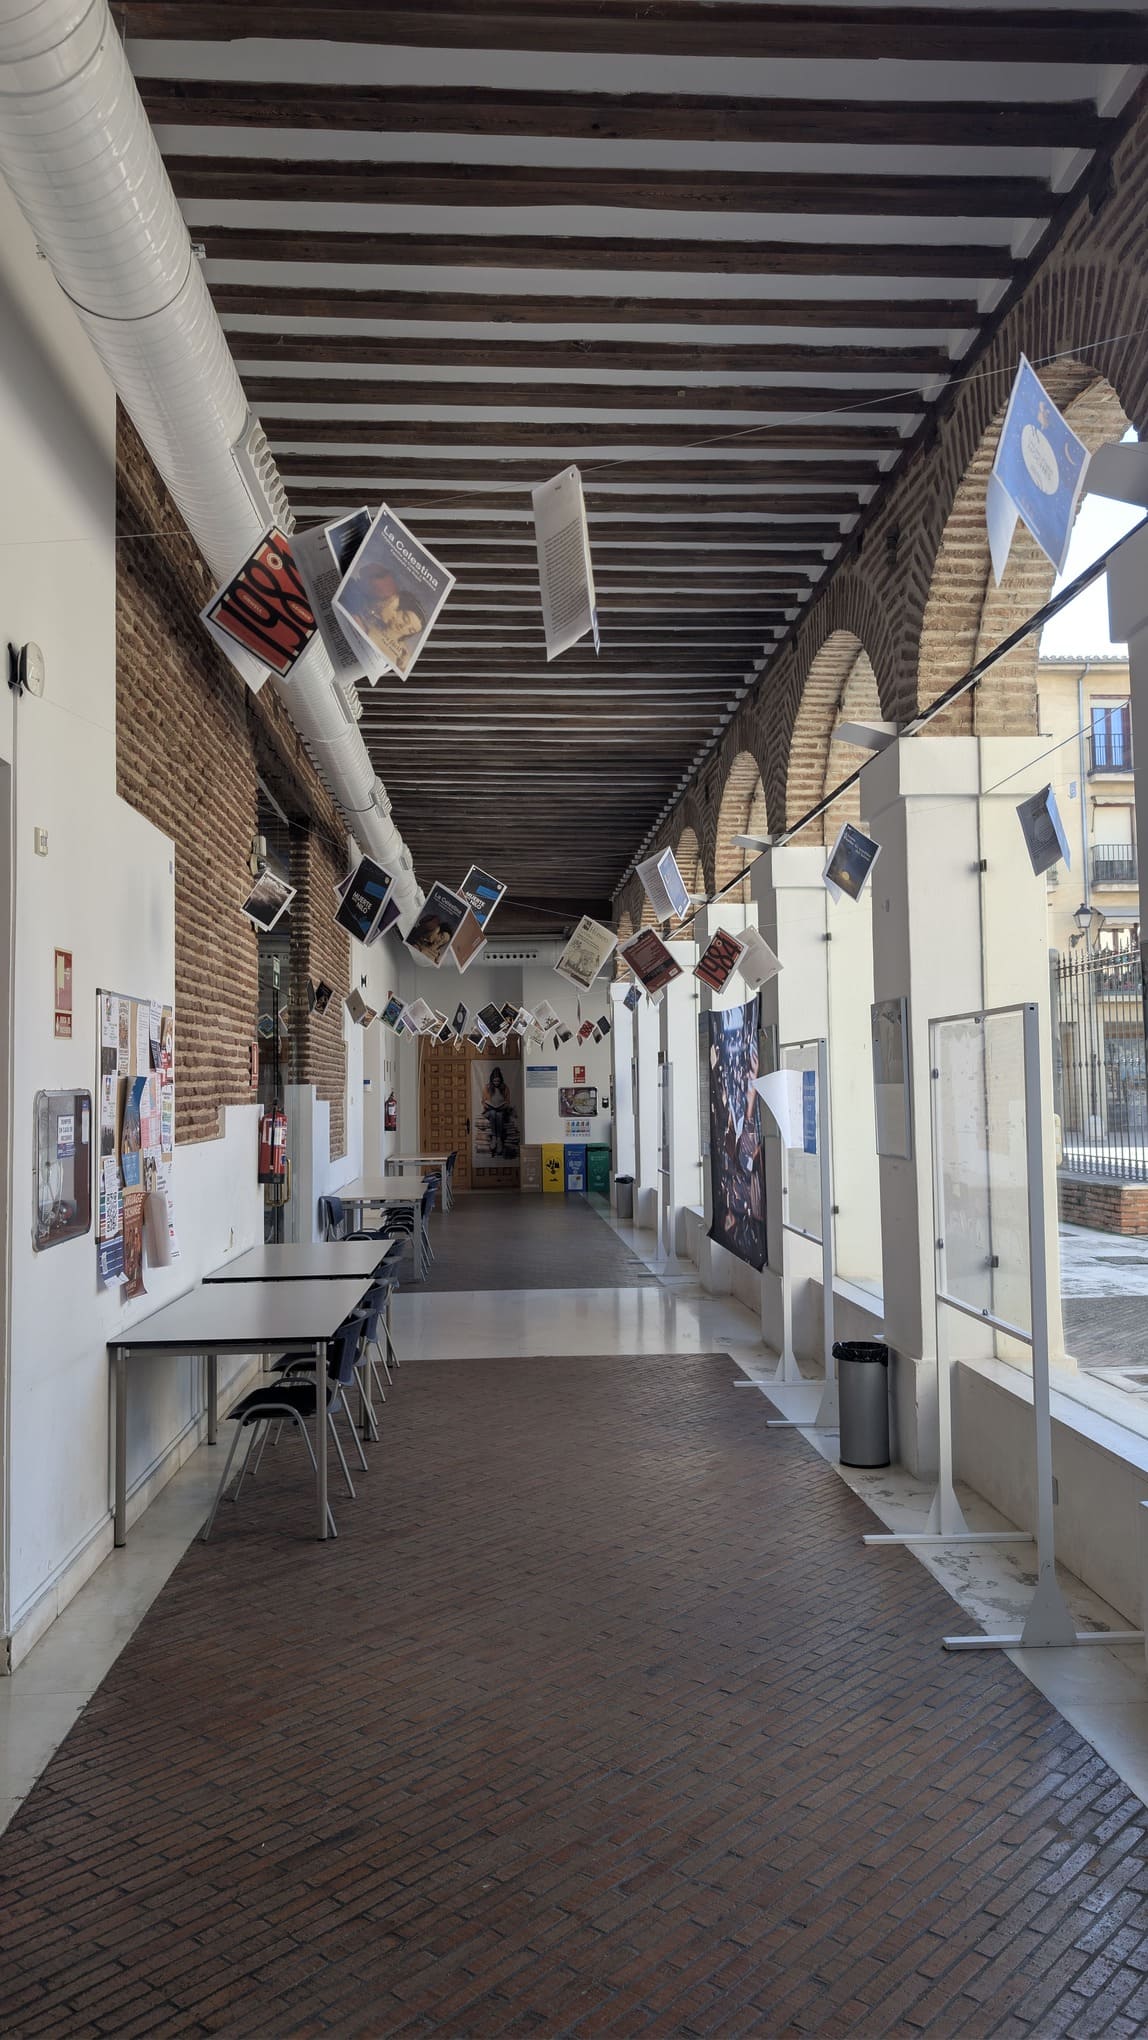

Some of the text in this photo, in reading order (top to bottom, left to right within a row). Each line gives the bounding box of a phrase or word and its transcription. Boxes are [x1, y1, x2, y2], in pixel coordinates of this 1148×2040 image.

[383, 525, 395, 542] La
[396, 540, 439, 587] Celestina
[353, 891, 372, 910] MUERTE
[698, 930, 743, 986] 1984
